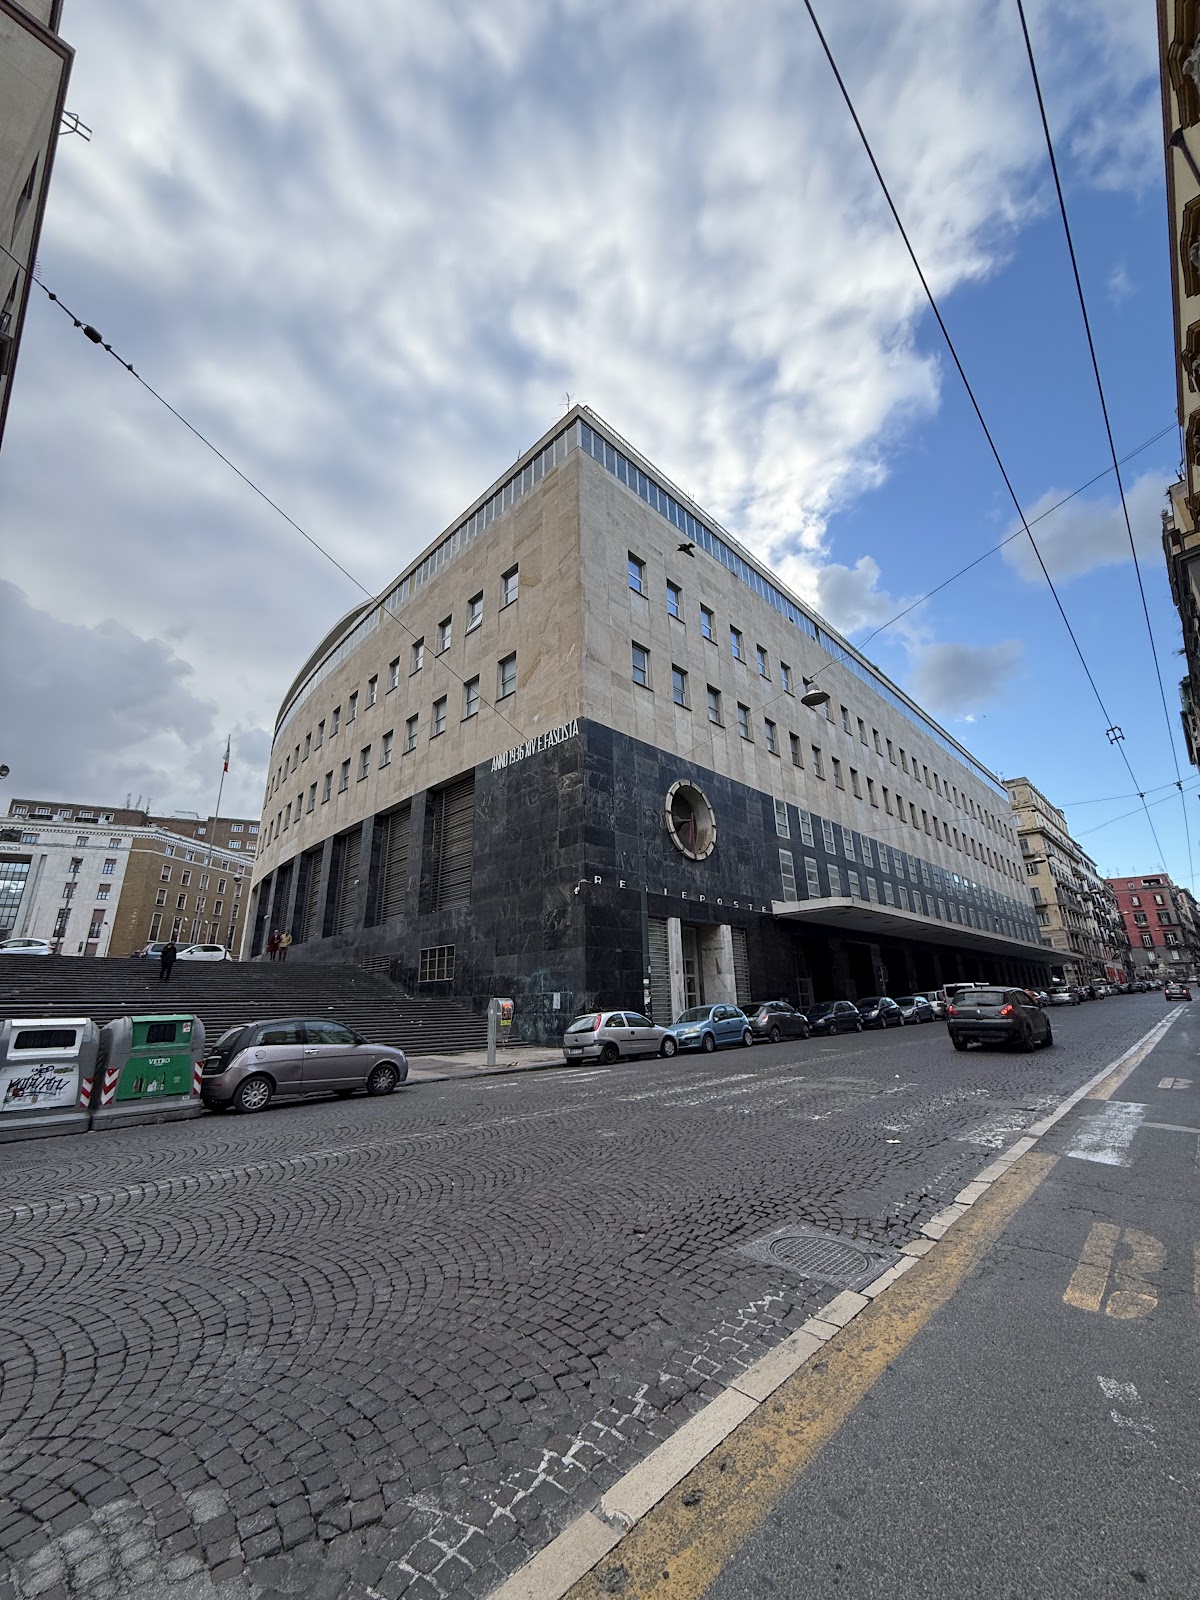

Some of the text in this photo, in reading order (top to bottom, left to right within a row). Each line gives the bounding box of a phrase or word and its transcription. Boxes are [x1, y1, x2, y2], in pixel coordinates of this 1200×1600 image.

[491, 751, 509, 773] ANNO
[509, 744, 524, 764] 1936
[525, 738, 536, 758] XIV
[148, 1057, 171, 1065] VETRO
